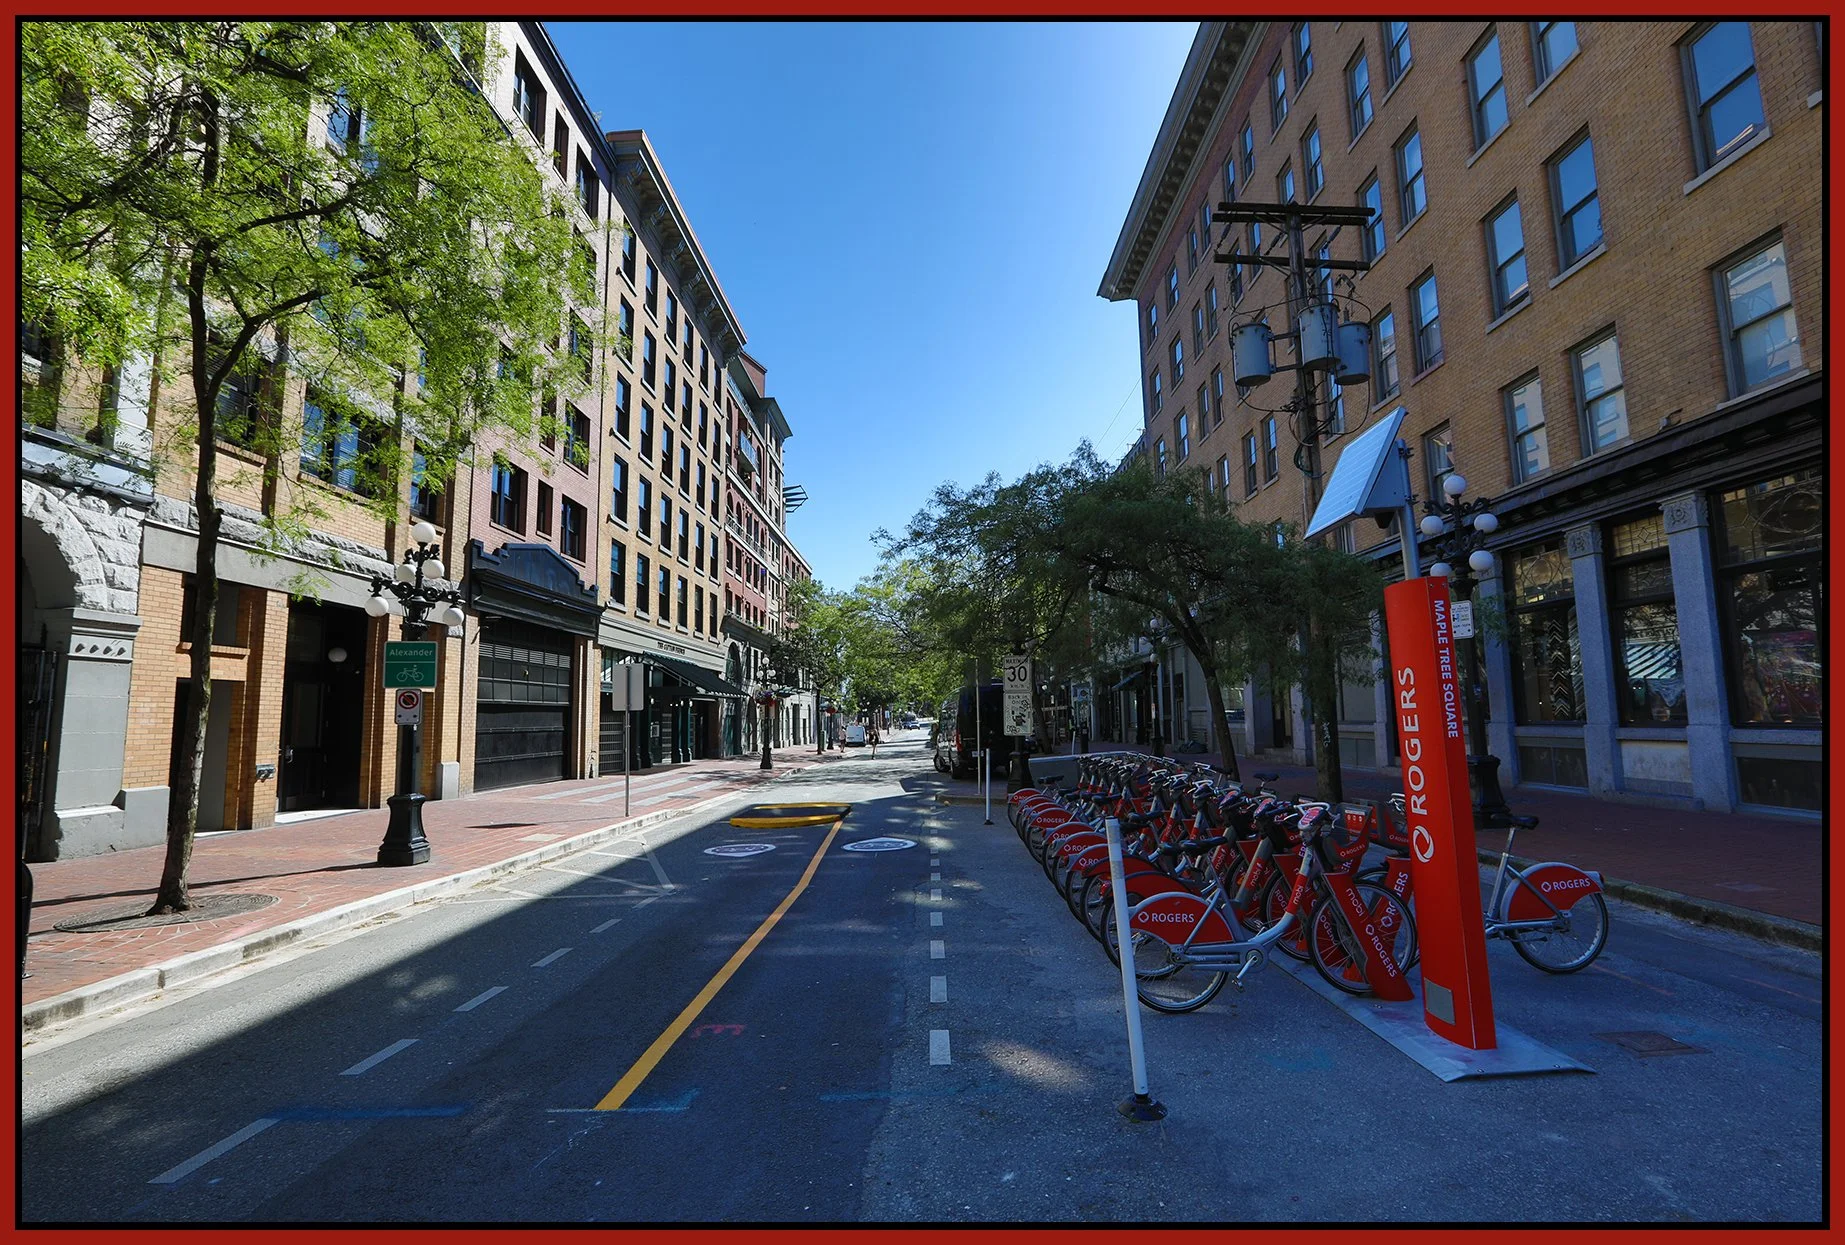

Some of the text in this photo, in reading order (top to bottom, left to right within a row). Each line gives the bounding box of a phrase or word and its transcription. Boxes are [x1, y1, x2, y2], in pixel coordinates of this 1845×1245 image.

[389, 648, 433, 656] Alexander
[1007, 666, 1027, 682] 30
[1434, 599, 1459, 738] MAPLE TREE SQUARE
[1398, 666, 1428, 816] ROGERS
[1552, 878, 1591, 890] ROGERS
[1345, 888, 1365, 917] mobi
[1151, 912, 1195, 923] ROGERS
[1371, 935, 1398, 978] ROGERS
